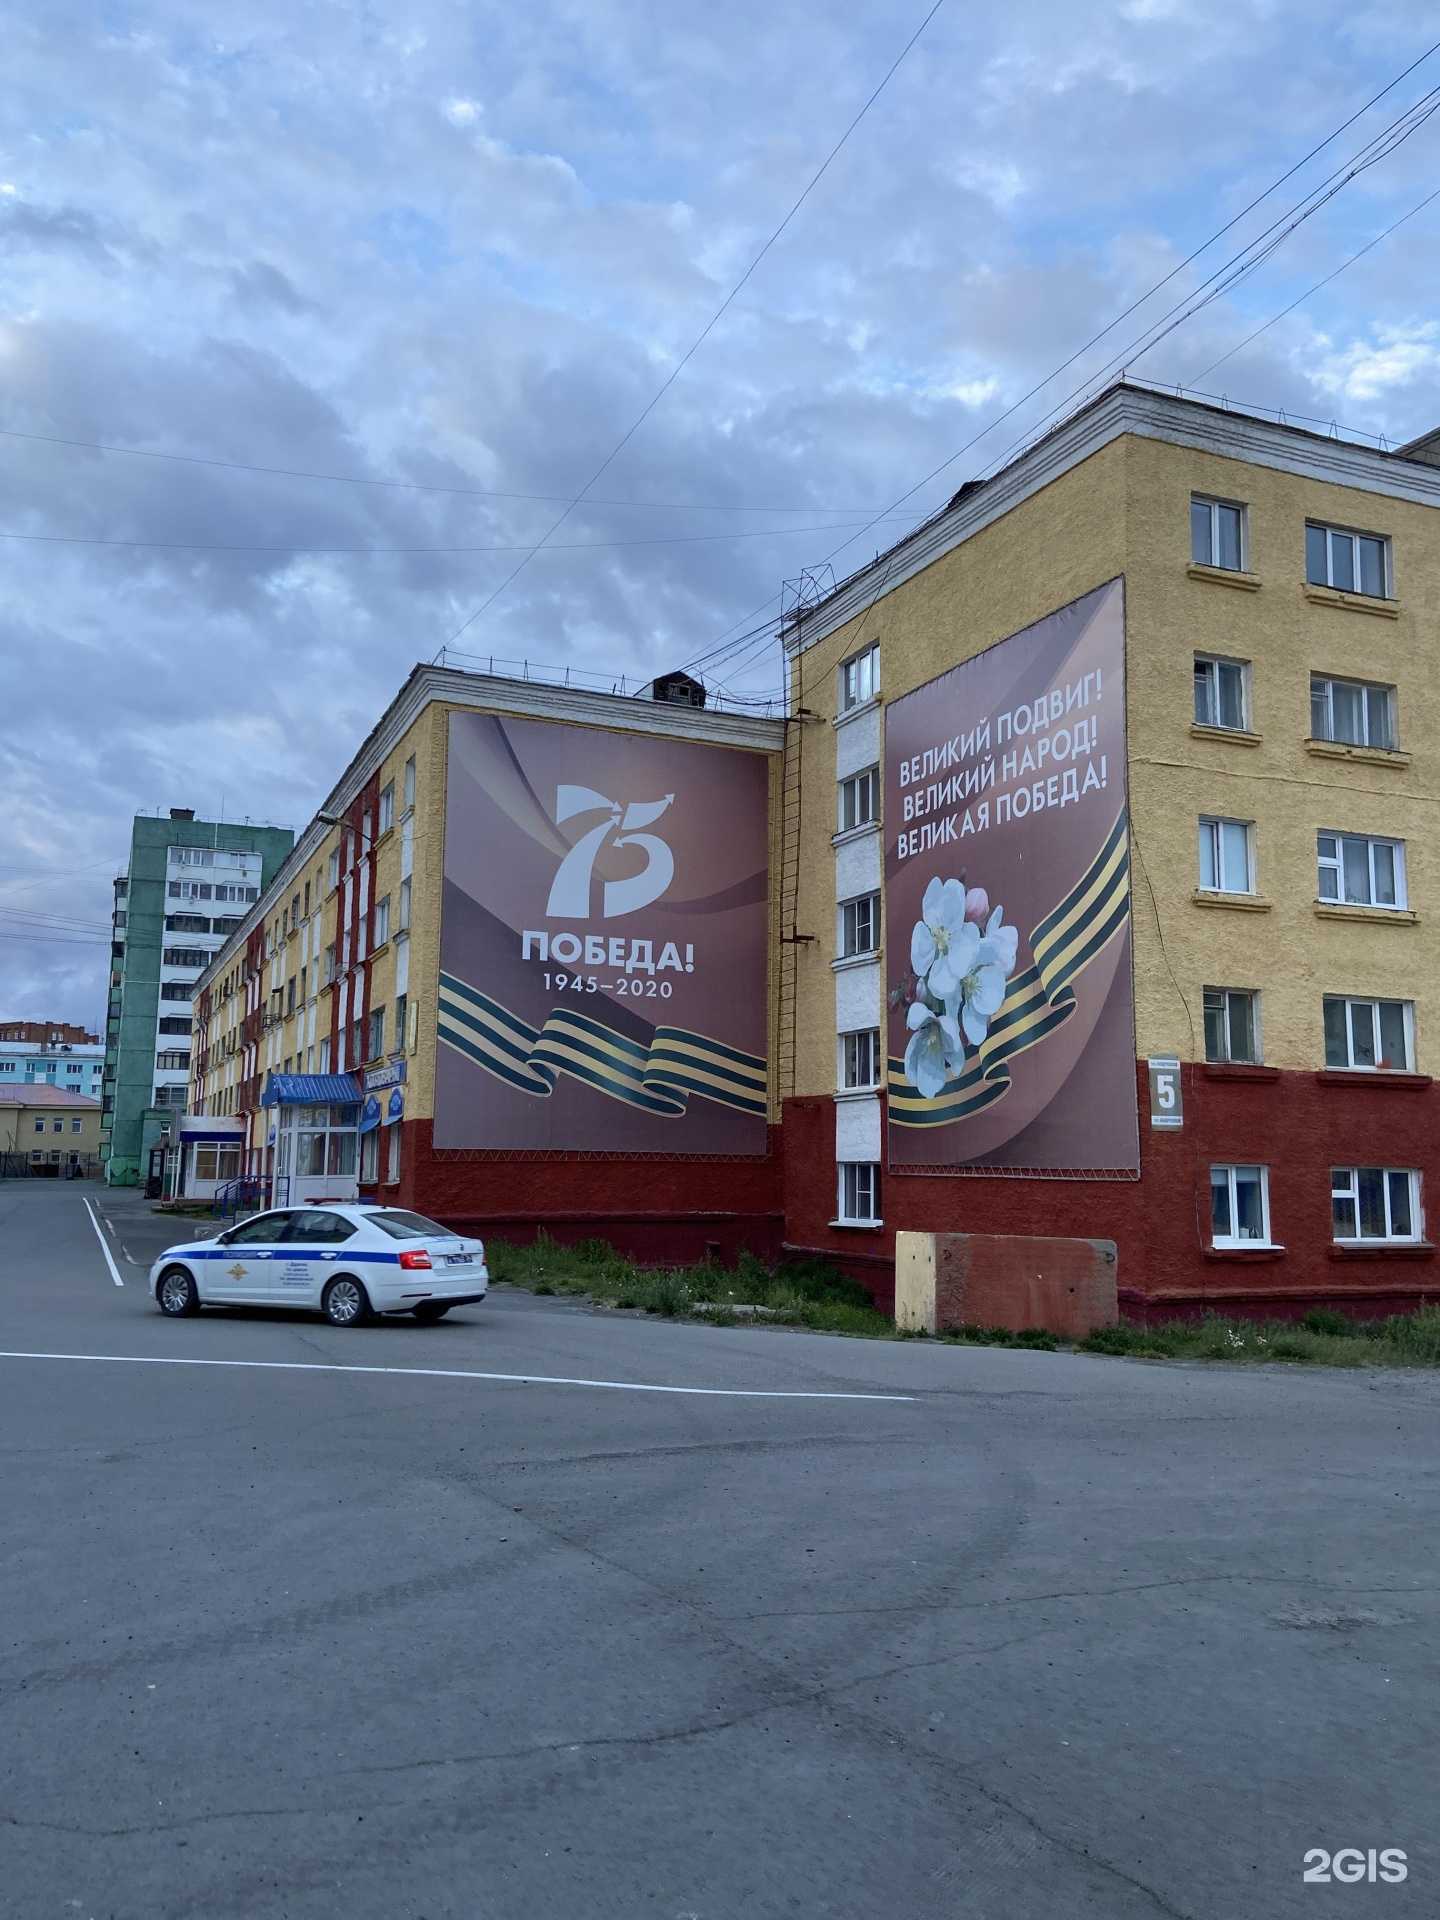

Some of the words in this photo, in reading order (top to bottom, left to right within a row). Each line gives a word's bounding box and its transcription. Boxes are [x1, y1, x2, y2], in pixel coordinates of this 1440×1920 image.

[899, 716, 991, 788] ВЕЛИКИЙ
[997, 668, 1102, 744] ПОДВИГ!
[903, 755, 995, 822] ВЕЛИКИЙ
[1002, 715, 1097, 783] НАРОД!
[897, 801, 990, 860] ВЕЛИКАЯ
[996, 755, 1107, 825] ПОБЕДА!
[521, 929, 695, 975] ПОБЕДА!
[1157, 1075, 1175, 1108] 5
